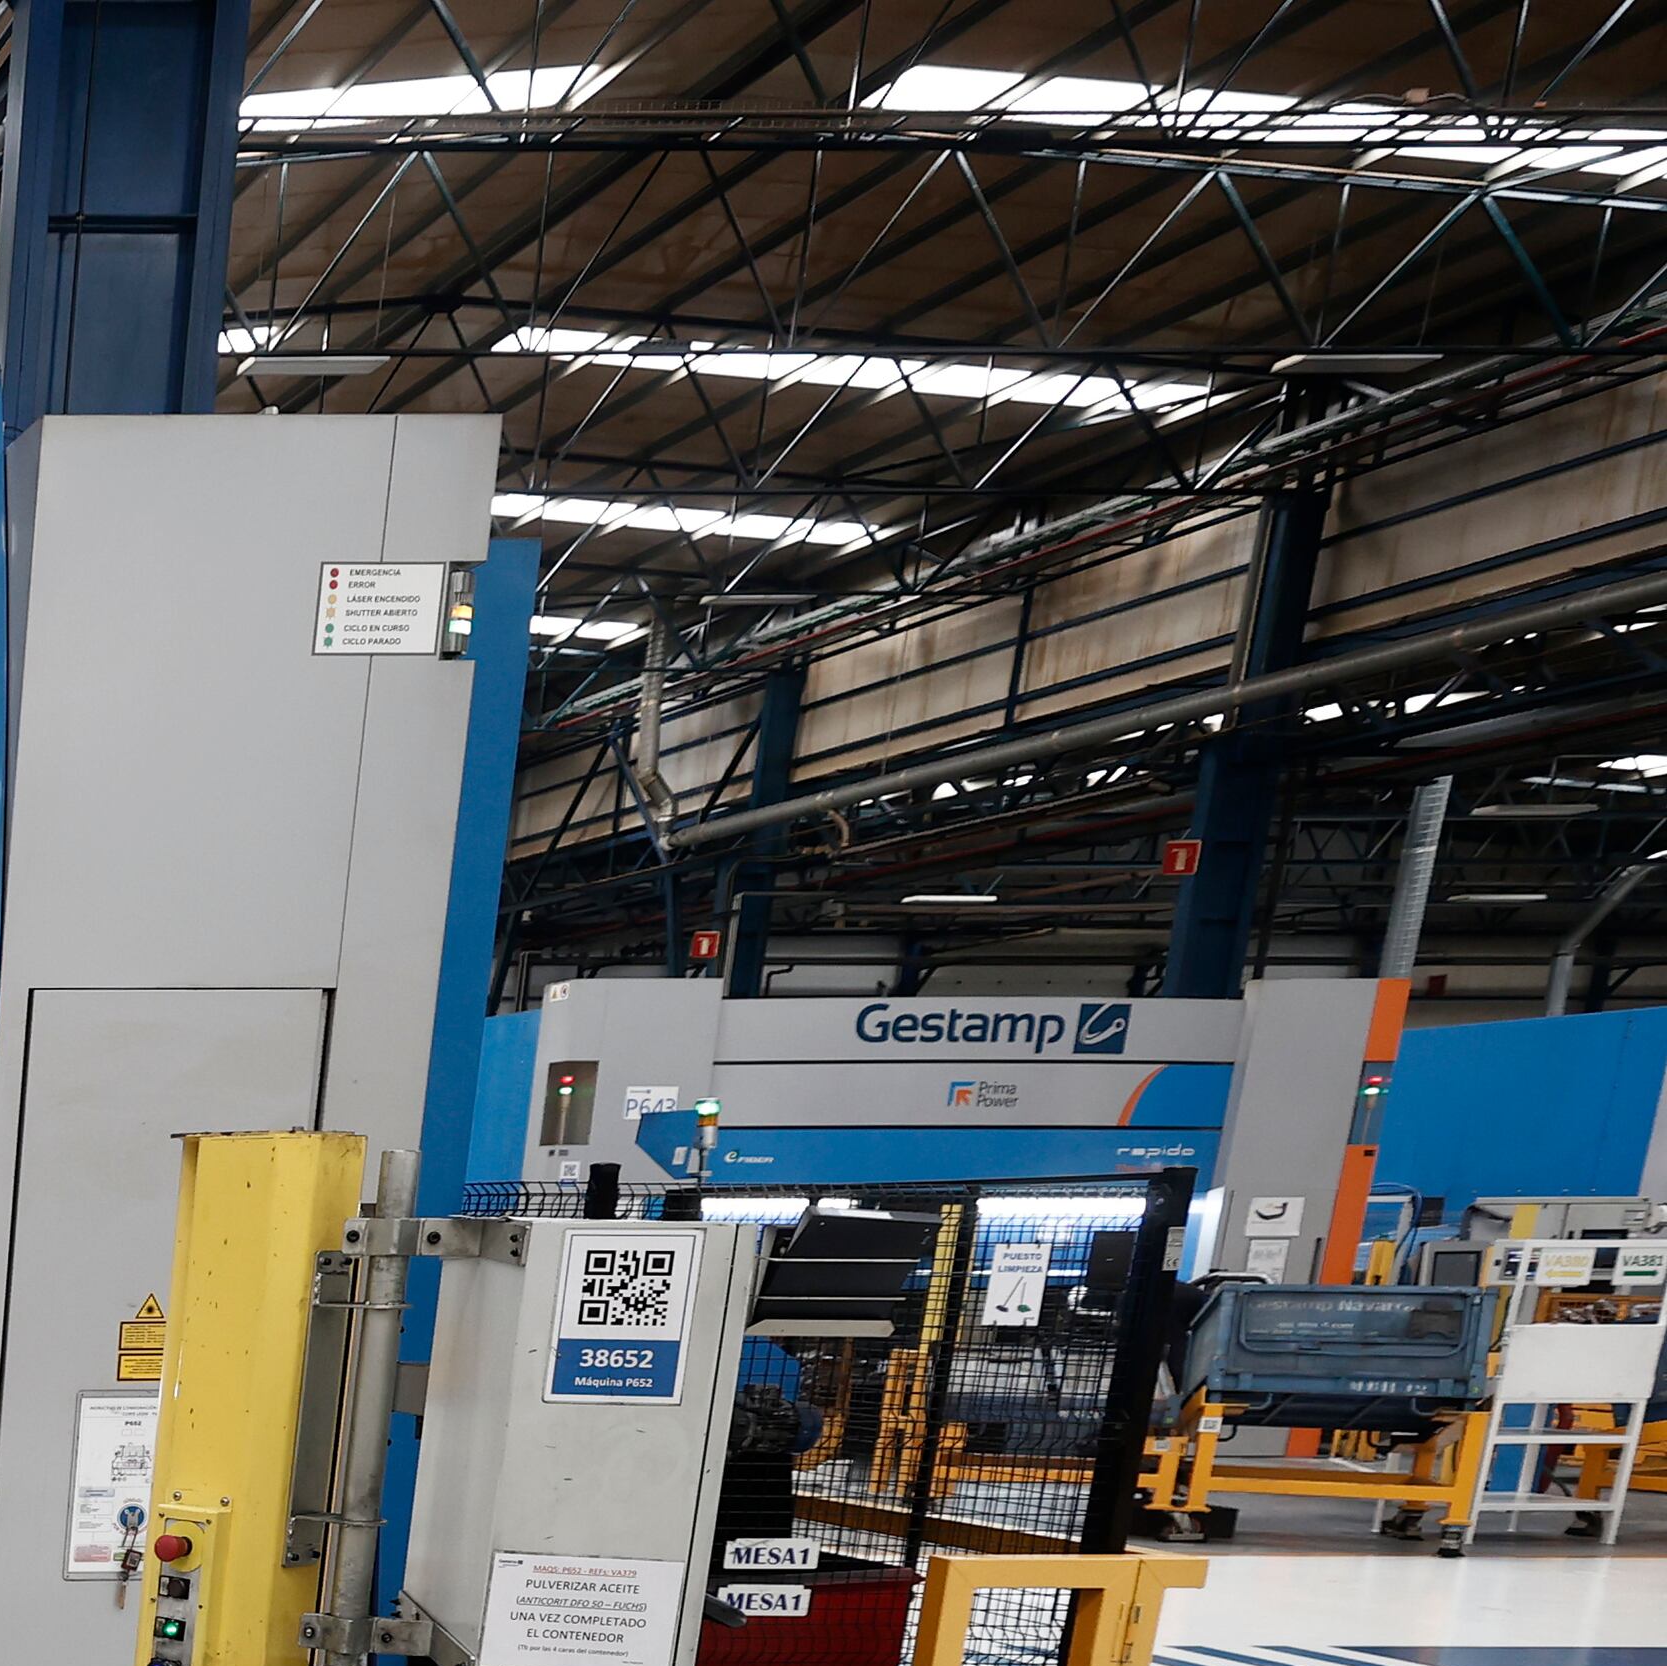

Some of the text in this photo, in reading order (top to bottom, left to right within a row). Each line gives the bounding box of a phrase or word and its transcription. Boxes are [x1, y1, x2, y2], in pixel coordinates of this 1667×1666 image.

[856, 1003, 1066, 1054] Gestamp
[978, 1081, 1018, 1095] Prima
[975, 1096, 1020, 1108] Power
[1116, 1143, 1196, 1159] rapido
[1003, 1252, 1043, 1261] PUESTO
[997, 1265, 1043, 1274] LIMPIEZA
[579, 1349, 655, 1369] 38652
[574, 1376, 653, 1388] Máquina P652
[525, 1579, 640, 1595] PULVERIZAR ACEITE
[510, 1611, 647, 1629] UNA VEZ COMPLETADO
[526, 1628, 624, 1643] EL CONTENEDOR
